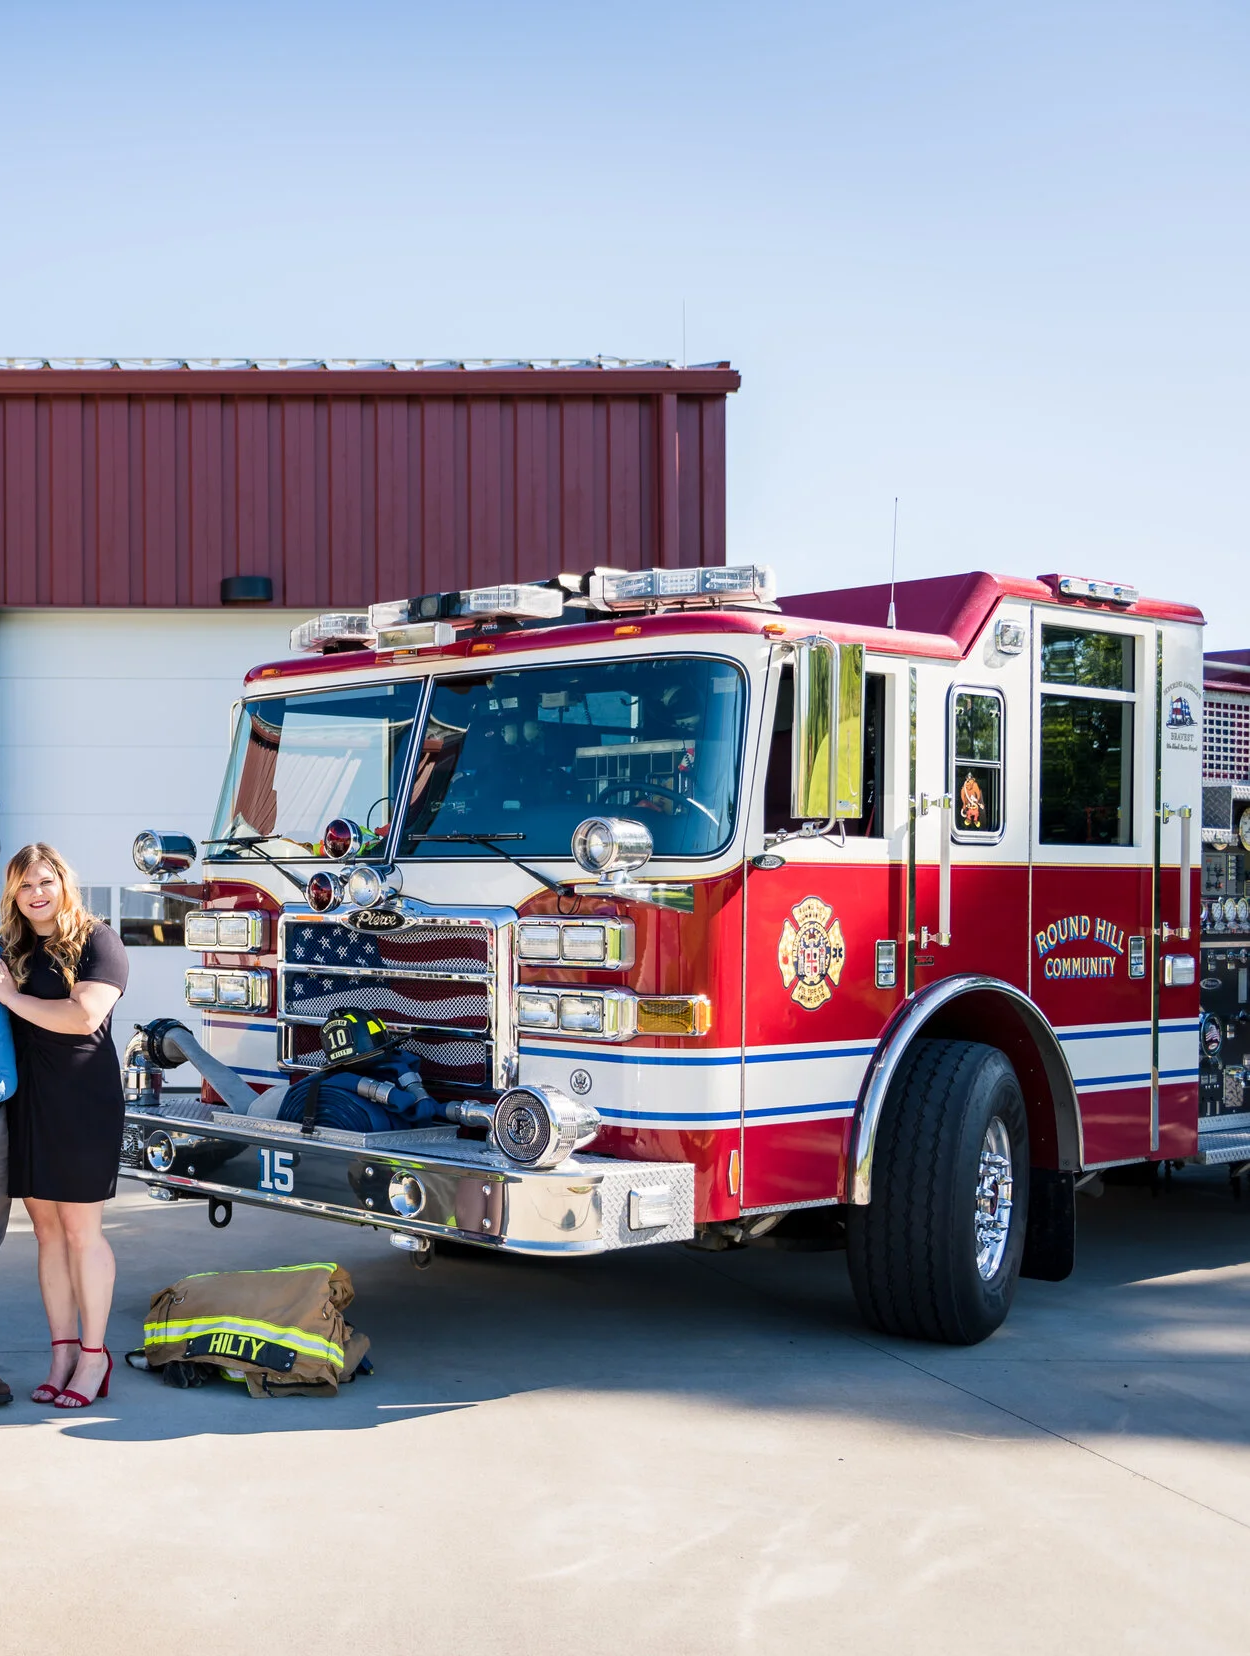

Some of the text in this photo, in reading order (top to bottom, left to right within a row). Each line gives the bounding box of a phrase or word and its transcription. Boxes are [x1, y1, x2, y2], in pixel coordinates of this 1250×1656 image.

[356, 910, 397, 929] Pierce
[1035, 915, 1124, 958] ROUND HILL
[1044, 956, 1116, 979] COMMUNITY
[328, 1029, 347, 1049] 10
[258, 1148, 293, 1195] 15
[208, 1333, 266, 1361] HILTY
